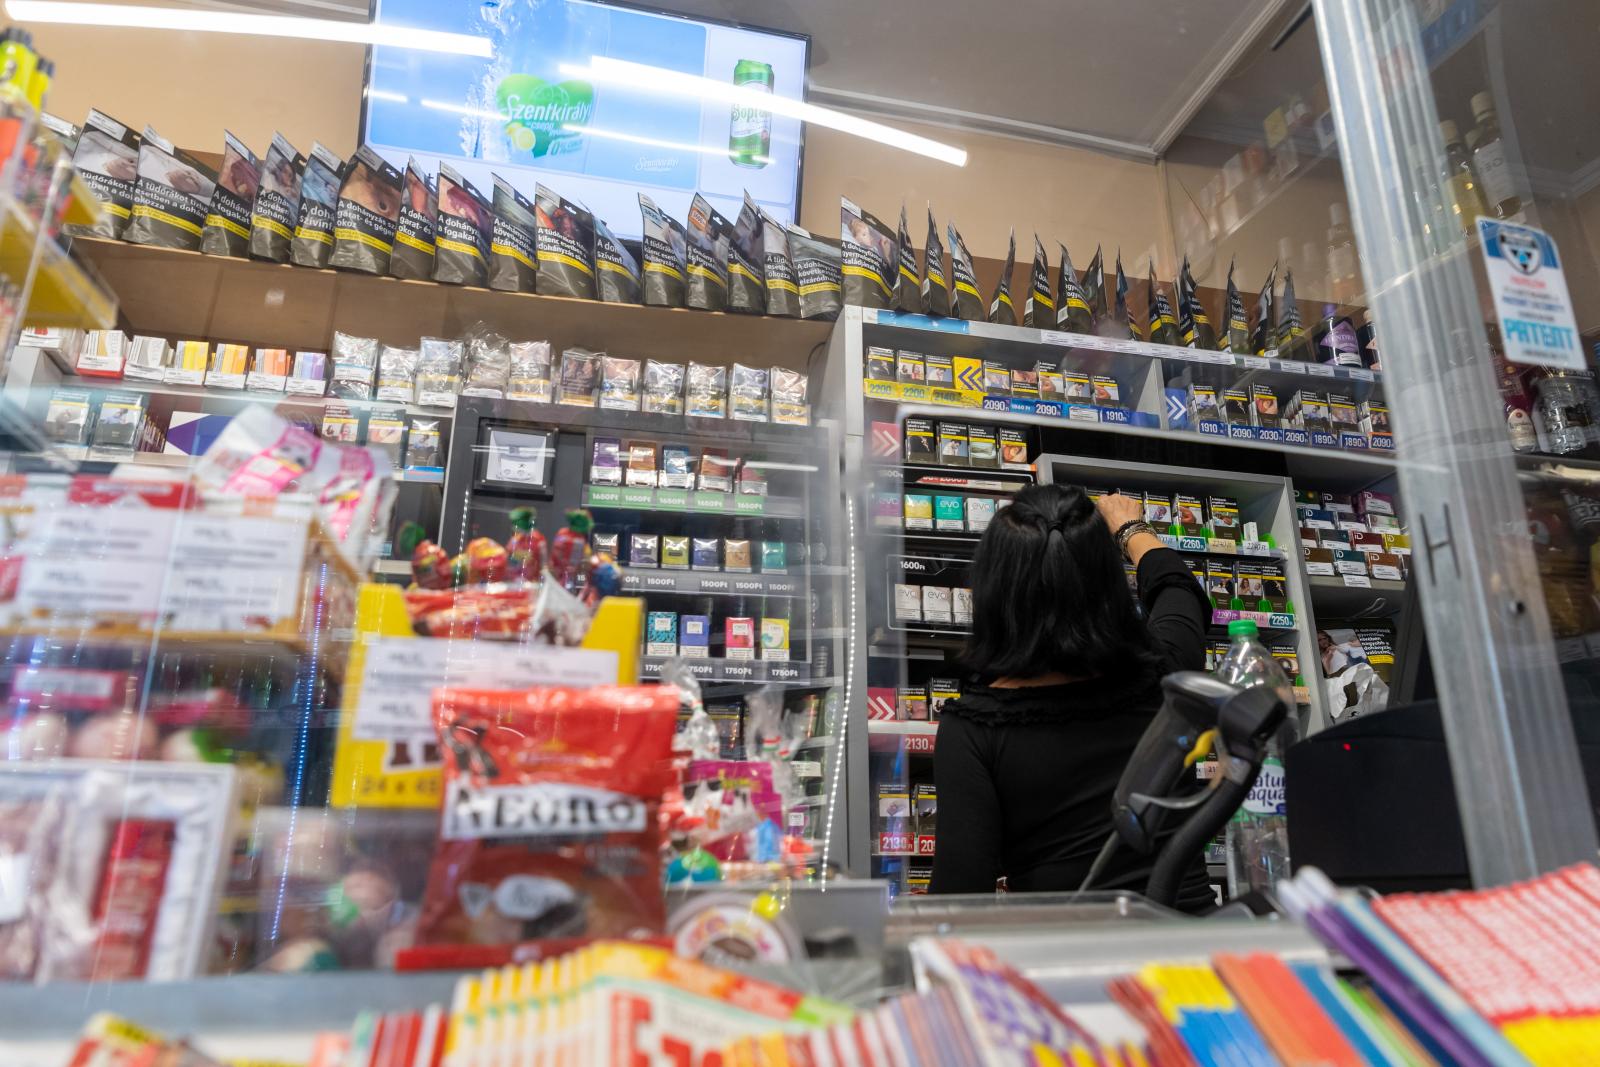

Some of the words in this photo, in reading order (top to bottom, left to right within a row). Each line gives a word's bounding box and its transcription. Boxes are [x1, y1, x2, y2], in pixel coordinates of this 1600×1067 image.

[137, 179, 144, 187] A
[146, 183, 189, 203] tüdőrákot
[213, 190, 220, 199] A
[260, 189, 266, 197] A
[134, 188, 170, 205] esetben
[134, 196, 165, 210] okozza
[301, 202, 308, 212] A
[338, 200, 345, 208] A
[217, 203, 250, 225] fogakat
[400, 206, 407, 214] A
[336, 218, 357, 228] okoz
[337, 210, 363, 221] garat-
[364, 217, 373, 226] és
[399, 216, 423, 229] garat-
[438, 214, 444, 223] A
[494, 218, 500, 226] A
[398, 225, 416, 238] okoz
[444, 226, 476, 243] fogakat
[597, 239, 604, 248] A
[1201, 422, 1218, 433] 1910
[940, 501, 960, 510] evo
[701, 580, 728, 589] 1500Ft
[735, 582, 763, 590] 1500Ft
[927, 591, 947, 600] evo
[689, 665, 713, 674] 750Ft
[905, 738, 928, 750] 2130
[1247, 789, 1286, 807] aqua
[882, 836, 907, 849] 2130
